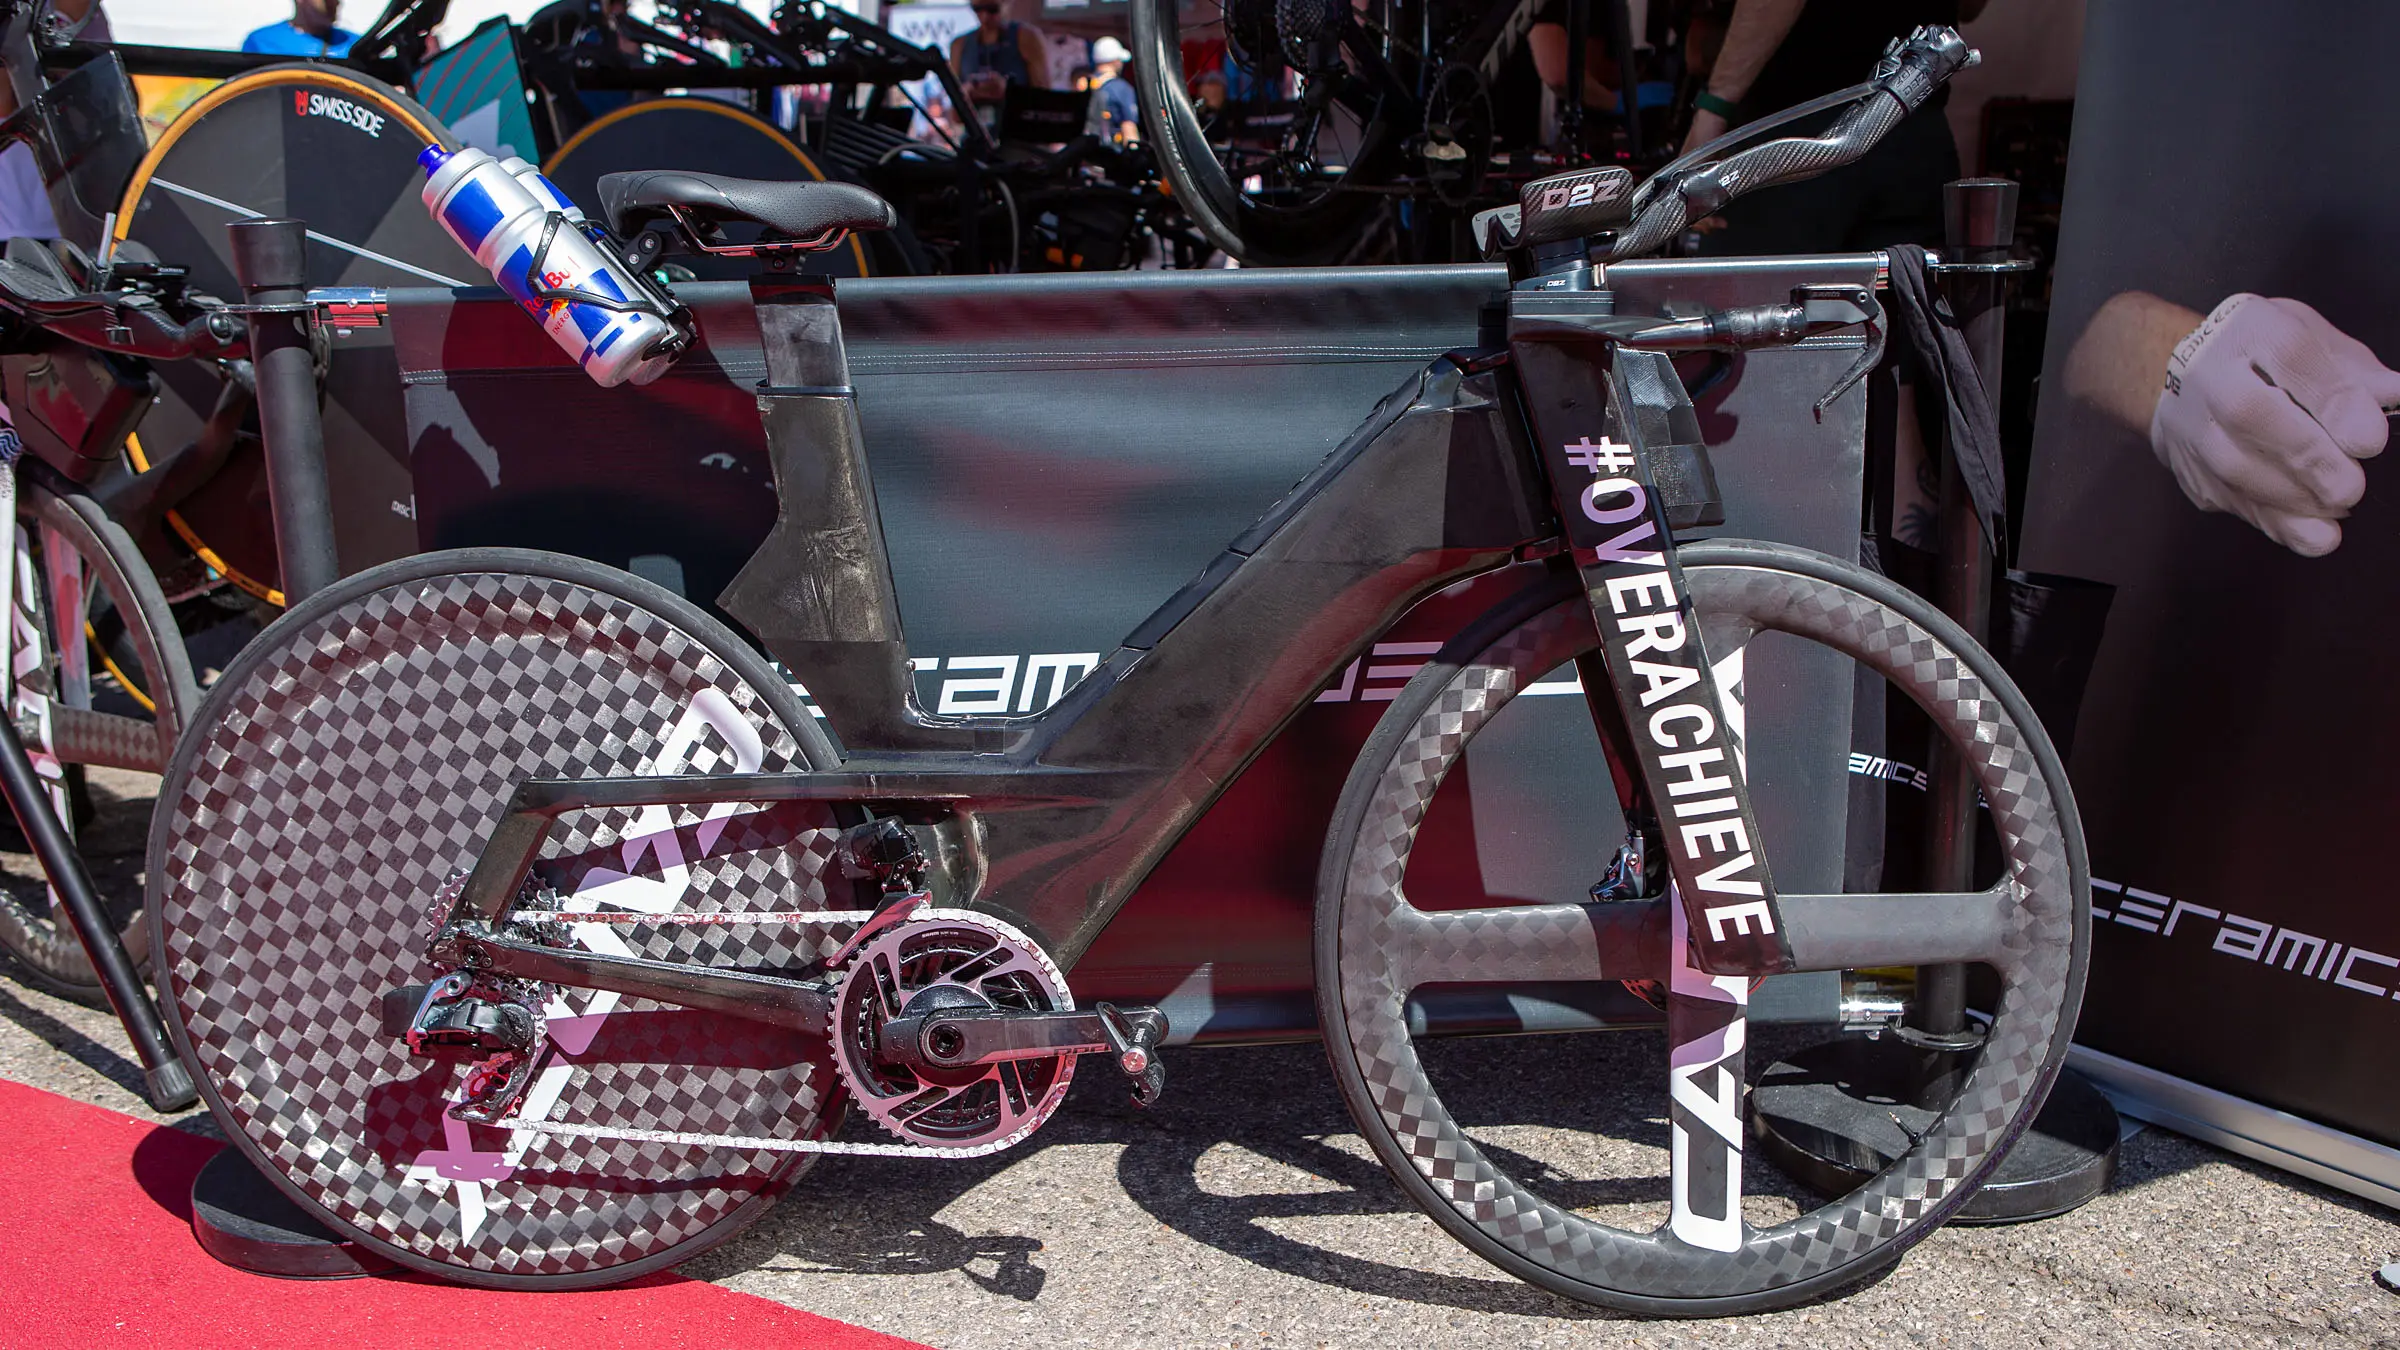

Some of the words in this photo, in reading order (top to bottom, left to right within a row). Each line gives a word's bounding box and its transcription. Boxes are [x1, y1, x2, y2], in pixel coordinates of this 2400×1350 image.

[309, 94, 354, 123] SWISS
[351, 106, 385, 138] SIDE
[1542, 178, 1622, 211] D2Z
[1718, 170, 1740, 187] 2Z
[1563, 436, 1775, 942] #OVERACHIEVE
[2091, 877, 2400, 1000] eramic
